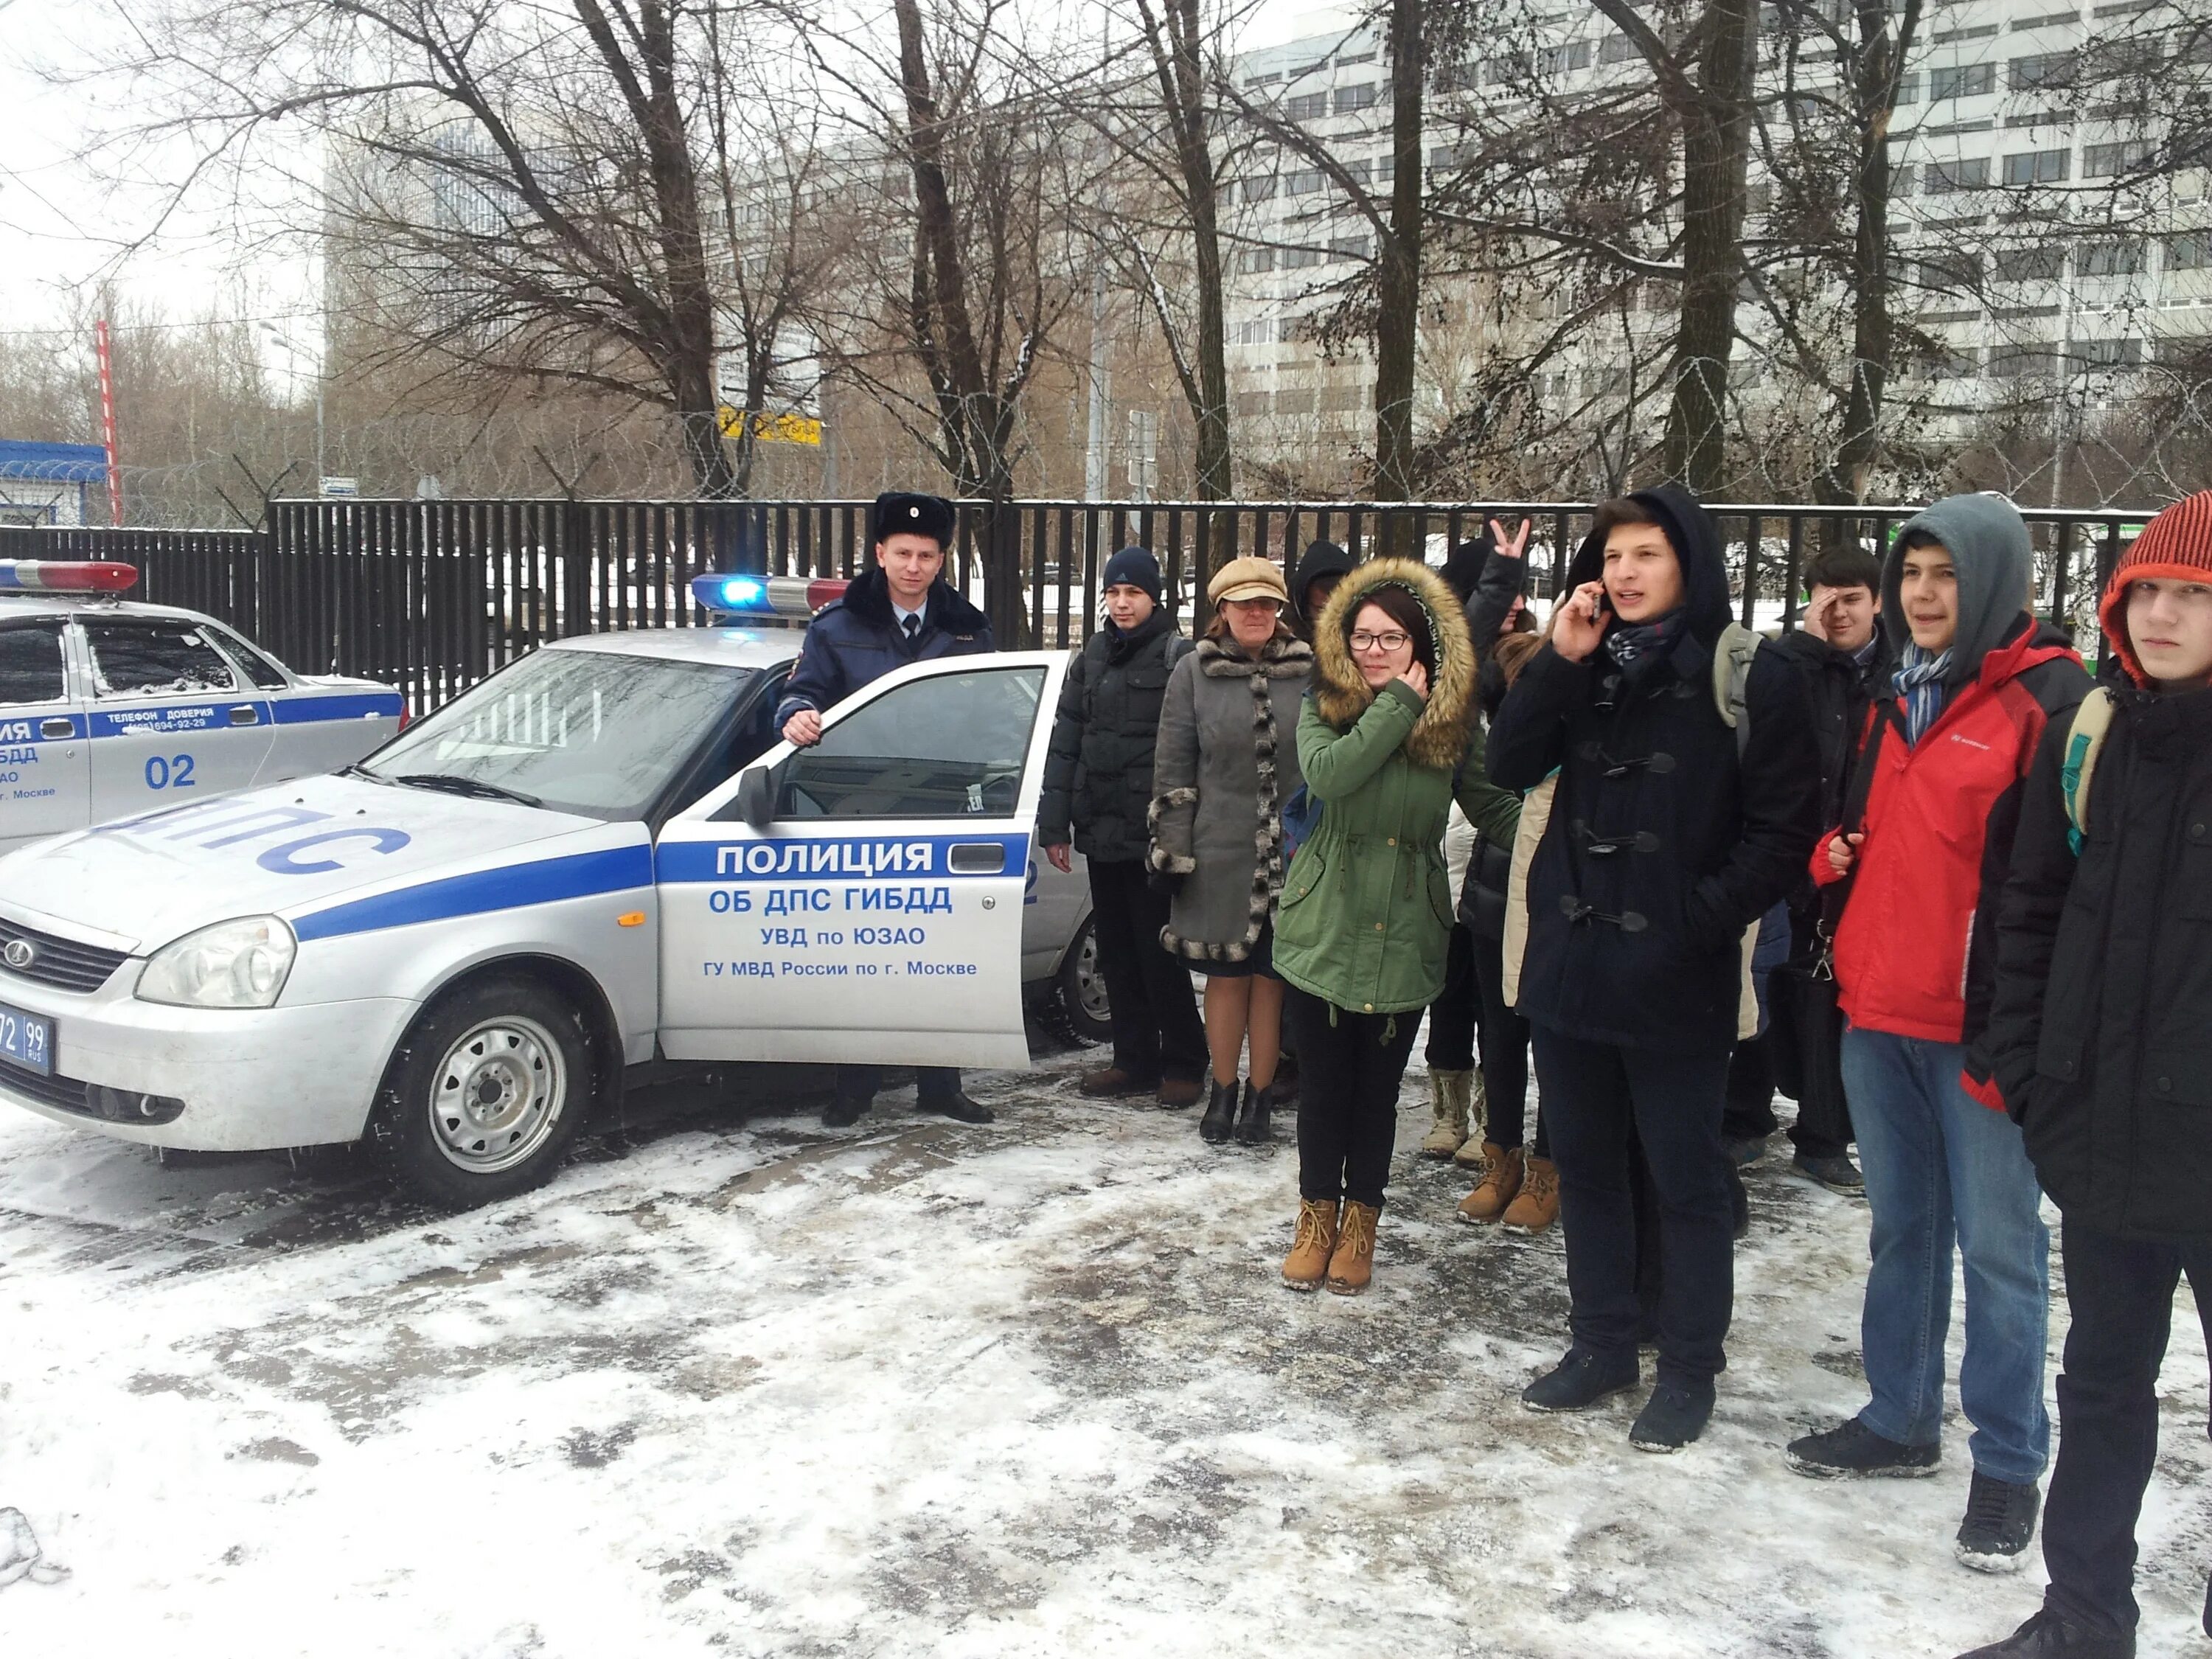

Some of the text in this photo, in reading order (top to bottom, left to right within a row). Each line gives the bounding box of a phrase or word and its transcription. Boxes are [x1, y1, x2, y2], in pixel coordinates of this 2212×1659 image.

[108, 708, 215, 723] ТЕЛЕФОН ДОВЕРИЯ
[145, 754, 195, 790] 02
[13, 788, 55, 799] Москве
[716, 843, 933, 877] ПОЛИЦИЯ
[709, 887, 953, 916] ОБ ДПС ГИБДД
[761, 928, 925, 947] УВД по ЮЗАО
[704, 961, 977, 978] ГУ МВД России по г. Москве
[27, 1022, 44, 1051] 99
[28, 1048, 41, 1062] RUS
